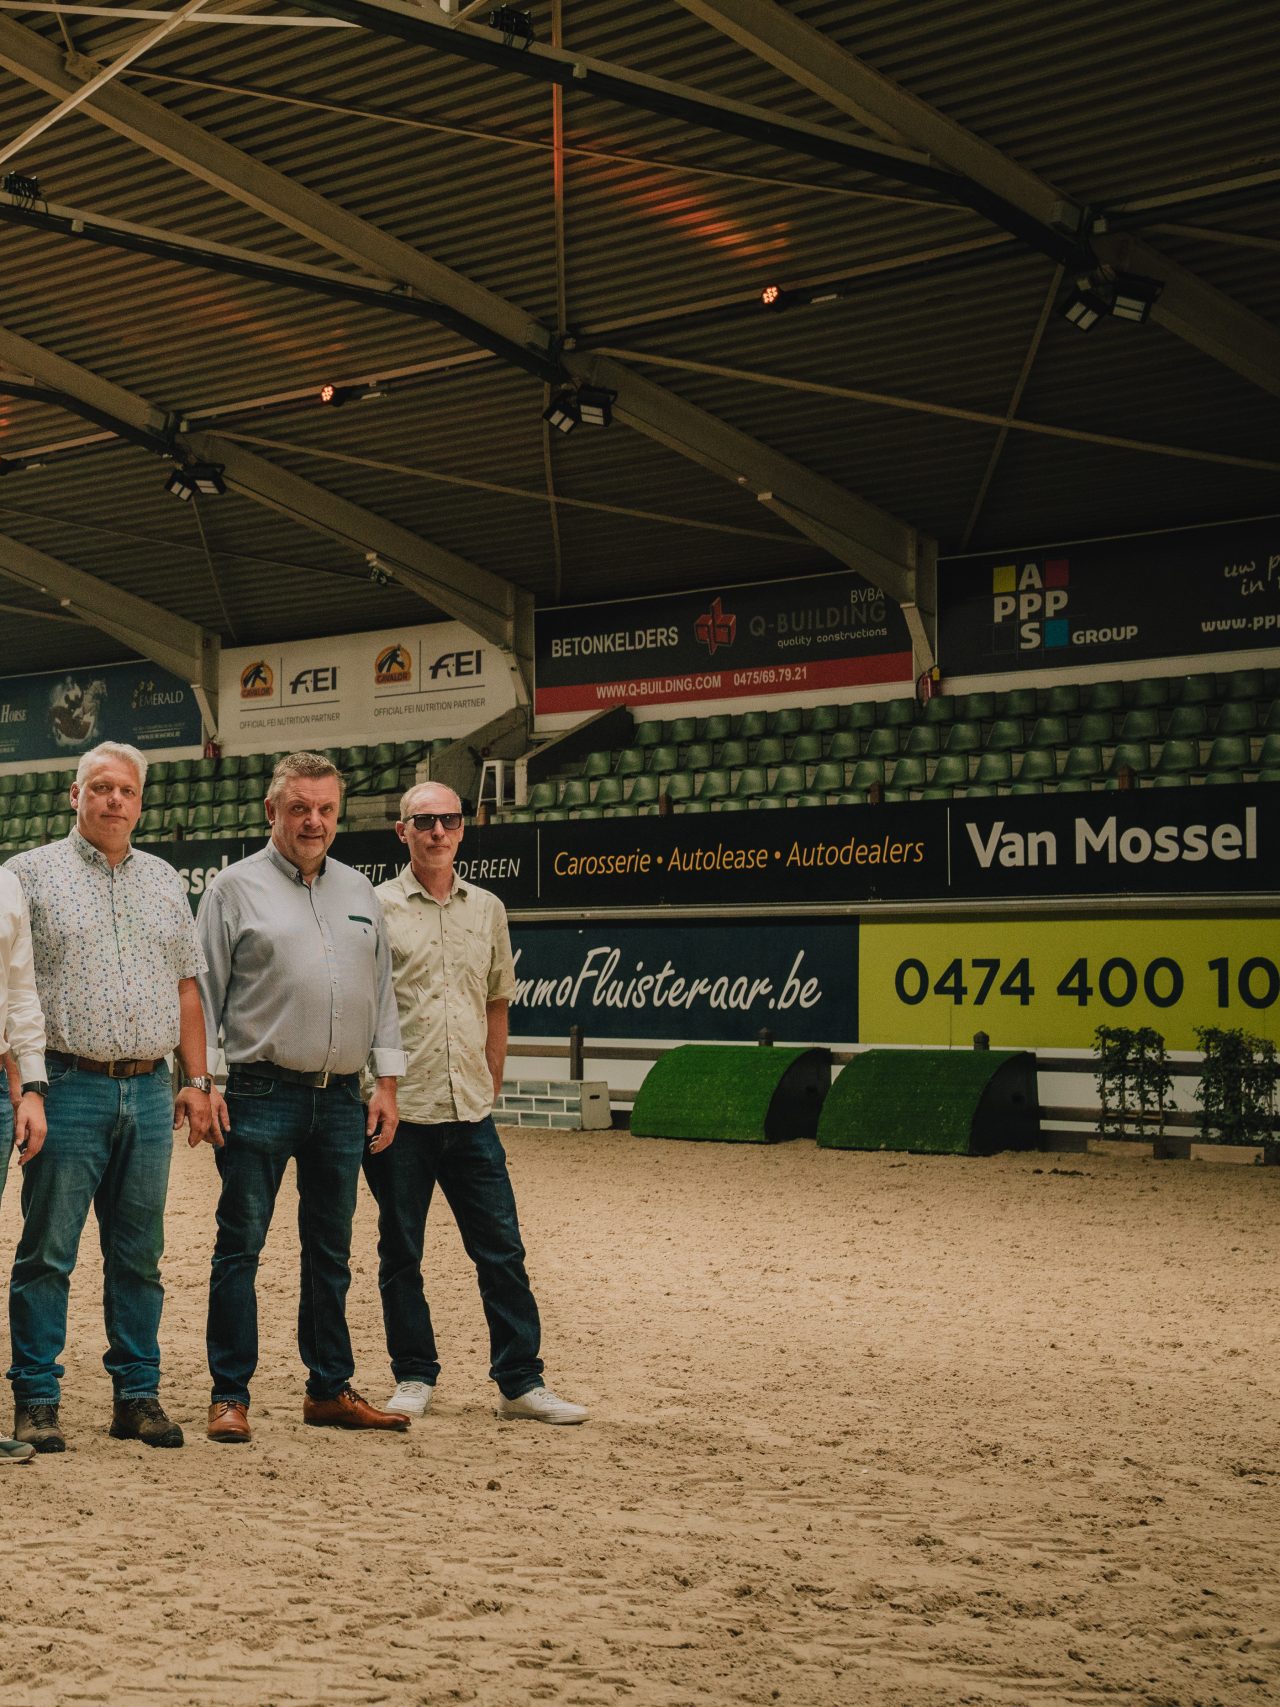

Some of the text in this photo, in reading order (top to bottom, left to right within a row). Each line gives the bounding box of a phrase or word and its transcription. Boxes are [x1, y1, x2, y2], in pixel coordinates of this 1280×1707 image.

[1019, 563, 1043, 591] A
[1241, 578, 1265, 596] in
[850, 588, 885, 604] BVBA
[749, 600, 887, 638] Q-BUILDING
[551, 626, 679, 658] BETONKELDERS
[777, 627, 887, 649] quality constructions
[1072, 625, 1139, 646] GROUP
[429, 650, 482, 679] FEI
[289, 666, 337, 694] FEI
[596, 667, 808, 699] WWW.Q-BUILDING.COM 0475/69.79.21
[139, 690, 184, 707] EMERALD
[374, 697, 486, 716] OFFICIAL FEI NUTRITION PARTNER
[0, 704, 27, 723] HORSE
[240, 712, 340, 729] OFFICIAL FEI NUTRITION PARTNER
[965, 806, 1257, 868] Van Mossel
[455, 858, 520, 880] DEREEN
[554, 835, 925, 876] Carosserie Autolease Autodealers
[178, 854, 228, 894] ssel
[895, 957, 1280, 1009] 0474 400 10
